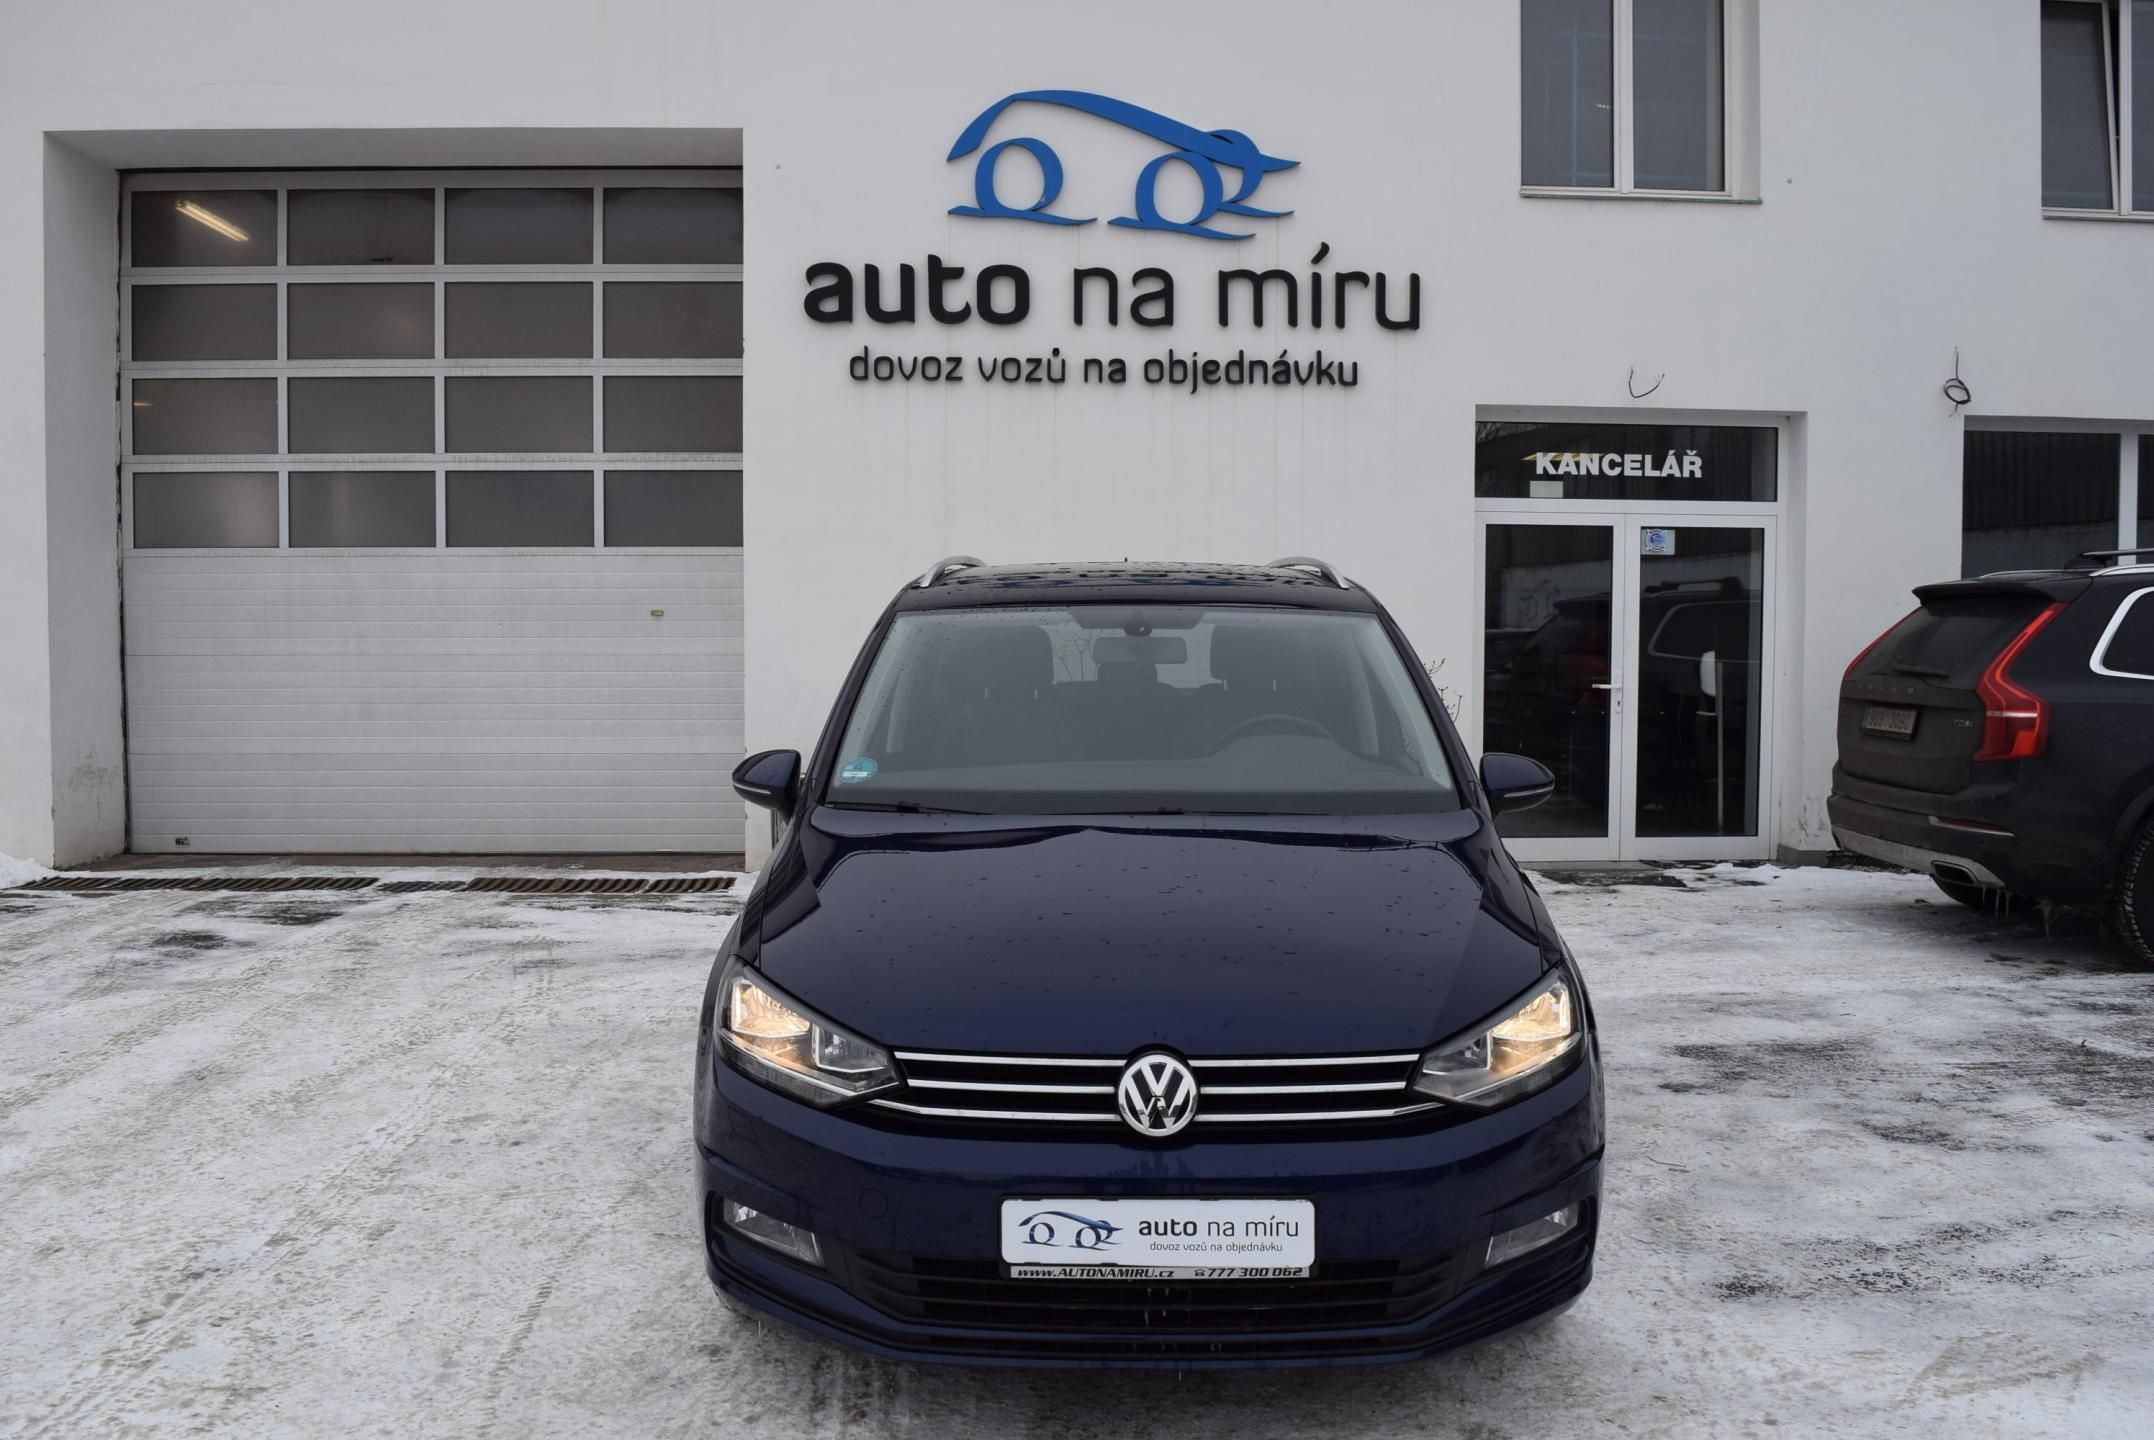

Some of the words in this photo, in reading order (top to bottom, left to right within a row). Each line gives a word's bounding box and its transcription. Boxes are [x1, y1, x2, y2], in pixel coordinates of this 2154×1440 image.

[804, 254, 1030, 326] auto
[1073, 266, 1175, 327] na
[1217, 241, 1421, 332] míru
[849, 346, 964, 383] dovoz
[977, 347, 1066, 384] vozů
[1083, 357, 1127, 385] na
[1143, 348, 1358, 395] objednávku
[1535, 449, 1703, 479] KANCELÁŘ
[1138, 1218, 1198, 1237] auto
[1207, 1221, 1235, 1237] na
[1245, 1215, 1299, 1238] míru
[1150, 1241, 1181, 1251] dovoz
[1183, 1241, 1207, 1252] vozů
[1210, 1243, 1223, 1252] na
[1225, 1241, 1283, 1254] objednávku
[1017, 1267, 1175, 1278] www.AUTONAMIRU.cz
[1207, 1267, 1236, 1278] 777
[1238, 1267, 1270, 1278] 300
[1271, 1266, 1303, 1277] 062
